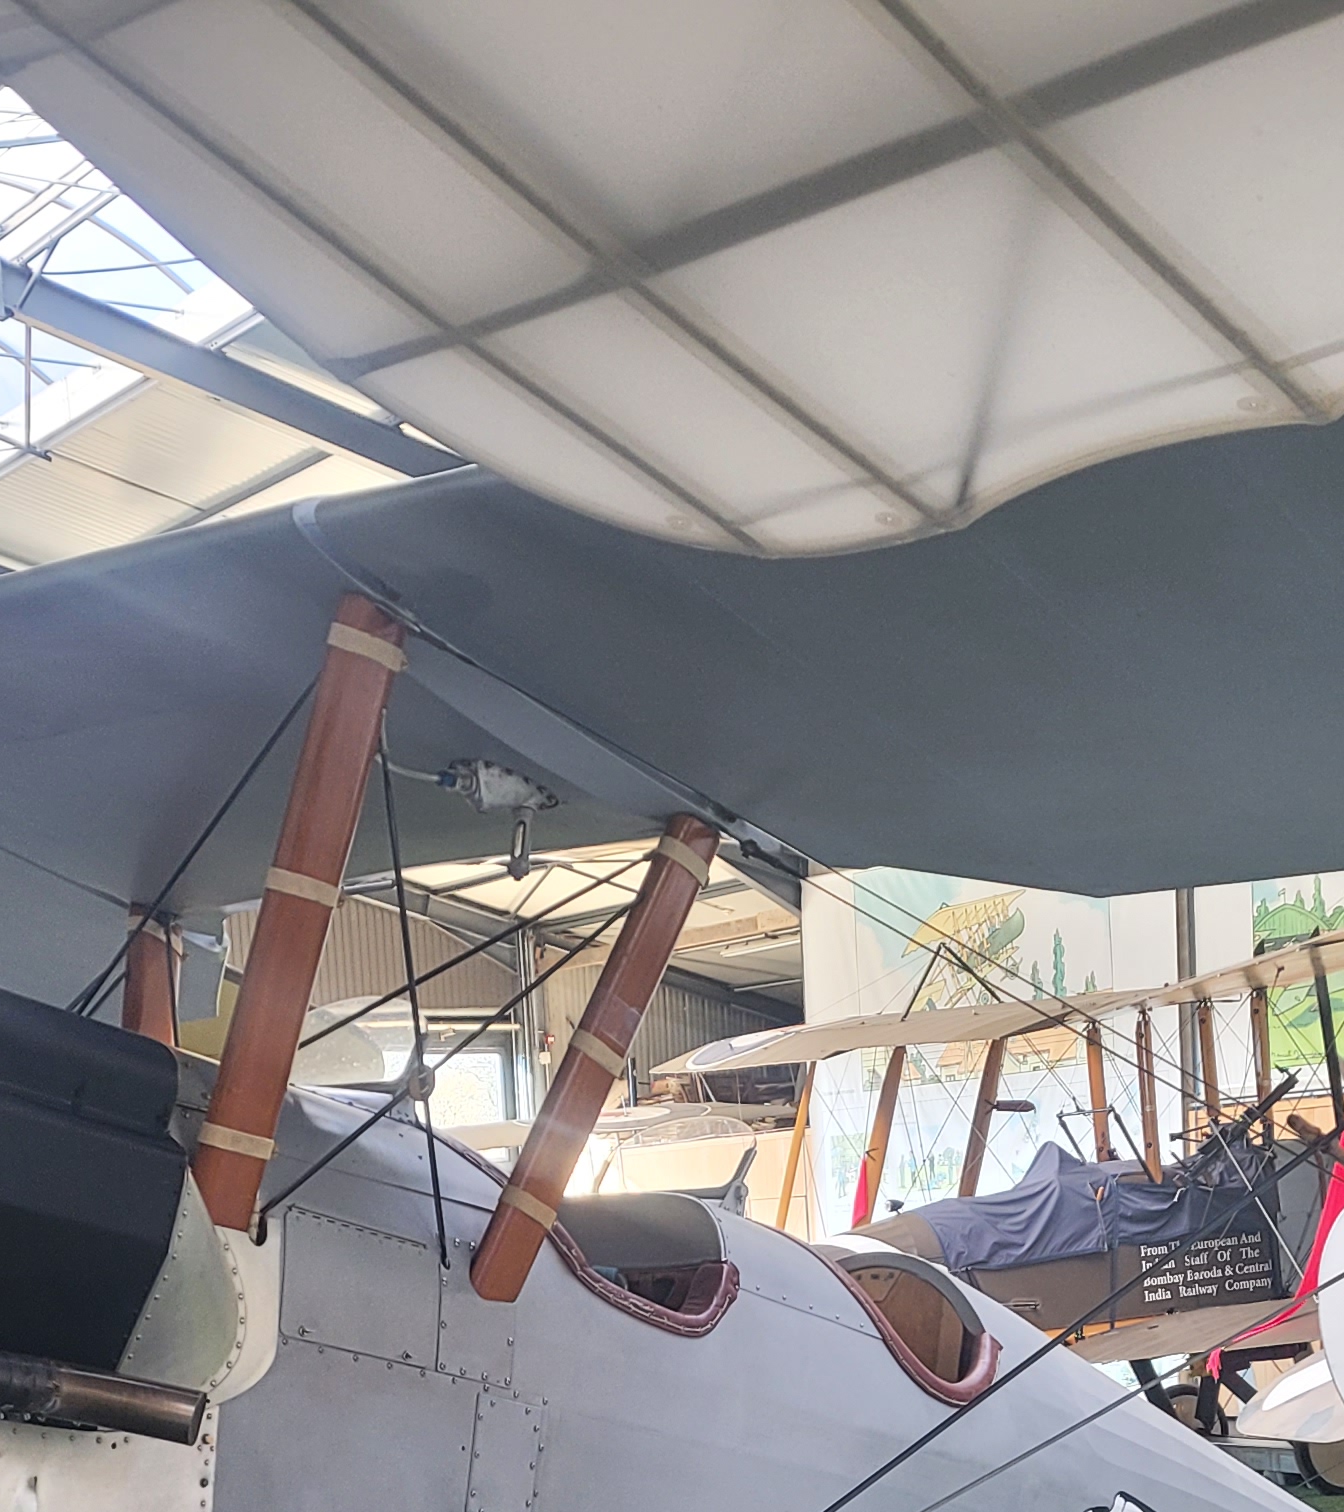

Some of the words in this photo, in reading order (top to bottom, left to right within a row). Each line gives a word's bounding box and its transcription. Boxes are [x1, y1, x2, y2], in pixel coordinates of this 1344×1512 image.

[1140, 1244, 1169, 1257] From
[1239, 1231, 1262, 1244] And
[1184, 1251, 1209, 1267] Staff
[1217, 1248, 1232, 1262] Of
[1239, 1246, 1260, 1259] The
[1143, 1271, 1185, 1288] Bombay
[1186, 1267, 1223, 1282] Baroda
[1224, 1265, 1234, 1276] &
[1235, 1259, 1273, 1275] Central
[1144, 1288, 1172, 1303] India
[1178, 1283, 1219, 1297] Railway
[1225, 1277, 1273, 1292] Company
